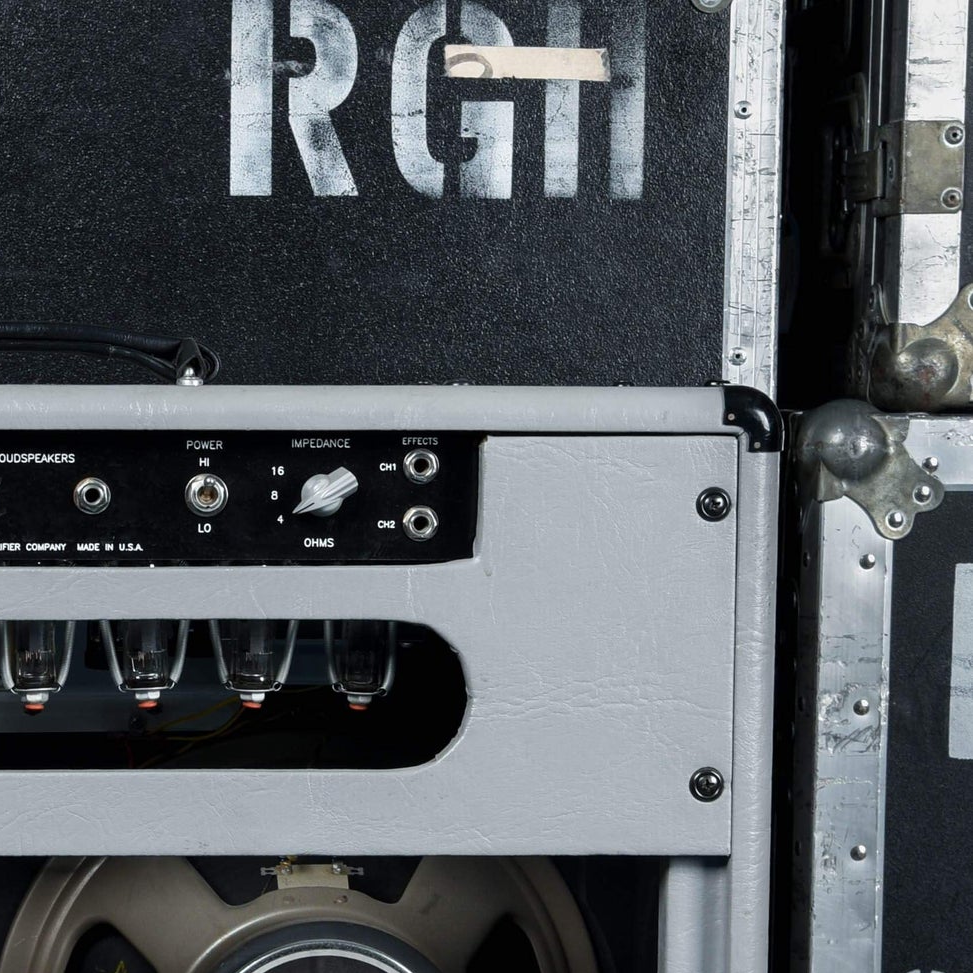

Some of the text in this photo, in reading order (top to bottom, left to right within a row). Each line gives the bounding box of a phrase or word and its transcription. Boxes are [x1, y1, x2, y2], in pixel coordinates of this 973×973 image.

[186, 440, 224, 451] POWER
[291, 438, 351, 449] IMPEDANCE
[401, 436, 439, 446] EFFECTS
[199, 457, 211, 467] HI
[379, 462, 397, 472] CH1
[271, 466, 286, 477] 16
[270, 490, 279, 501] 8
[276, 514, 285, 525] 4
[377, 520, 396, 530] CH2
[197, 523, 212, 534] LO
[26, 542, 67, 552] COMPANY
[76, 542, 100, 552] MADE
[104, 542, 114, 552] IN
[118, 542, 144, 552] U.S.A.
[303, 537, 335, 548] OHMS
